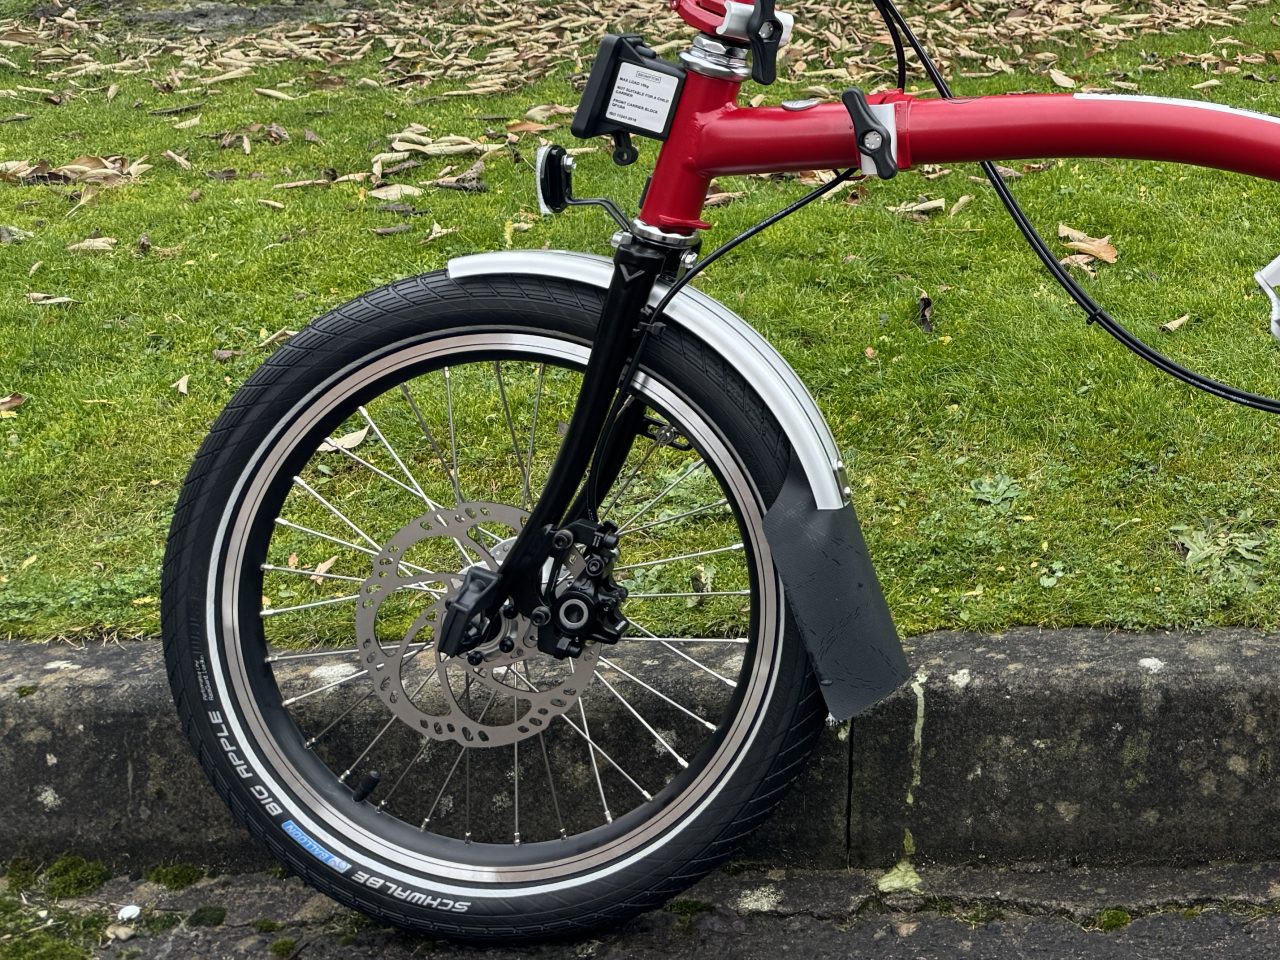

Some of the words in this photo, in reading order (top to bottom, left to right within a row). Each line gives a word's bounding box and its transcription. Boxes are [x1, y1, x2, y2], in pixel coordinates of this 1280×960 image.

[208, 709, 253, 779] APPLE
[250, 785, 284, 817] BIG
[285, 823, 331, 863] BALLOON
[351, 869, 472, 913] SCHWALBE
